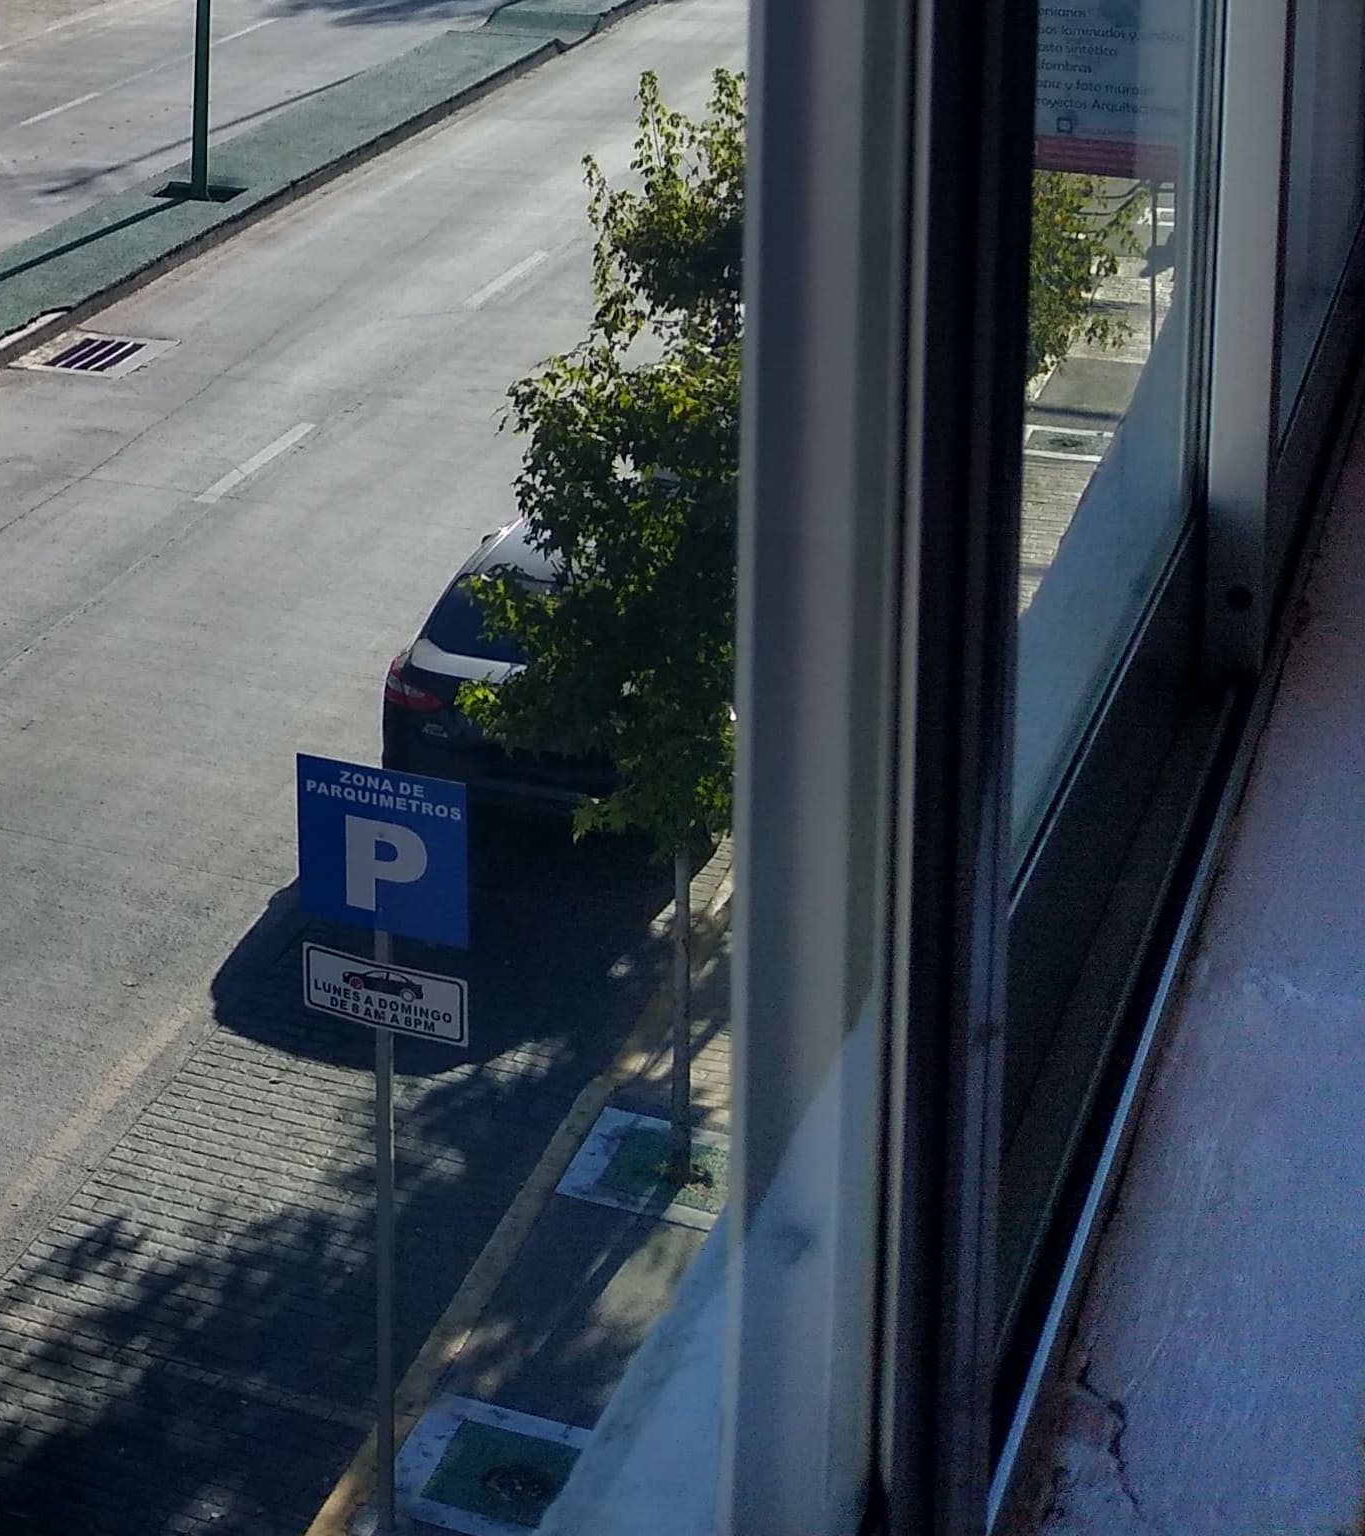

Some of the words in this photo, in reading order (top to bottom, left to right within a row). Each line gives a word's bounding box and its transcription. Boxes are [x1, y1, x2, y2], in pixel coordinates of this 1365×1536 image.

[1036, 97, 1088, 110] royectos
[306, 779, 462, 821] PARQUIMETROS
[339, 770, 394, 793] ZONA
[399, 782, 425, 798] DE
[345, 814, 427, 912] P
[314, 978, 361, 1002] LUNES
[364, 995, 373, 1007] A
[378, 997, 453, 1024] DOMINGO
[330, 996, 348, 1011] DE
[351, 1001, 360, 1013] 8
[364, 1005, 386, 1021] AM
[390, 1013, 400, 1025] A
[404, 1015, 436, 1032] 8PM
